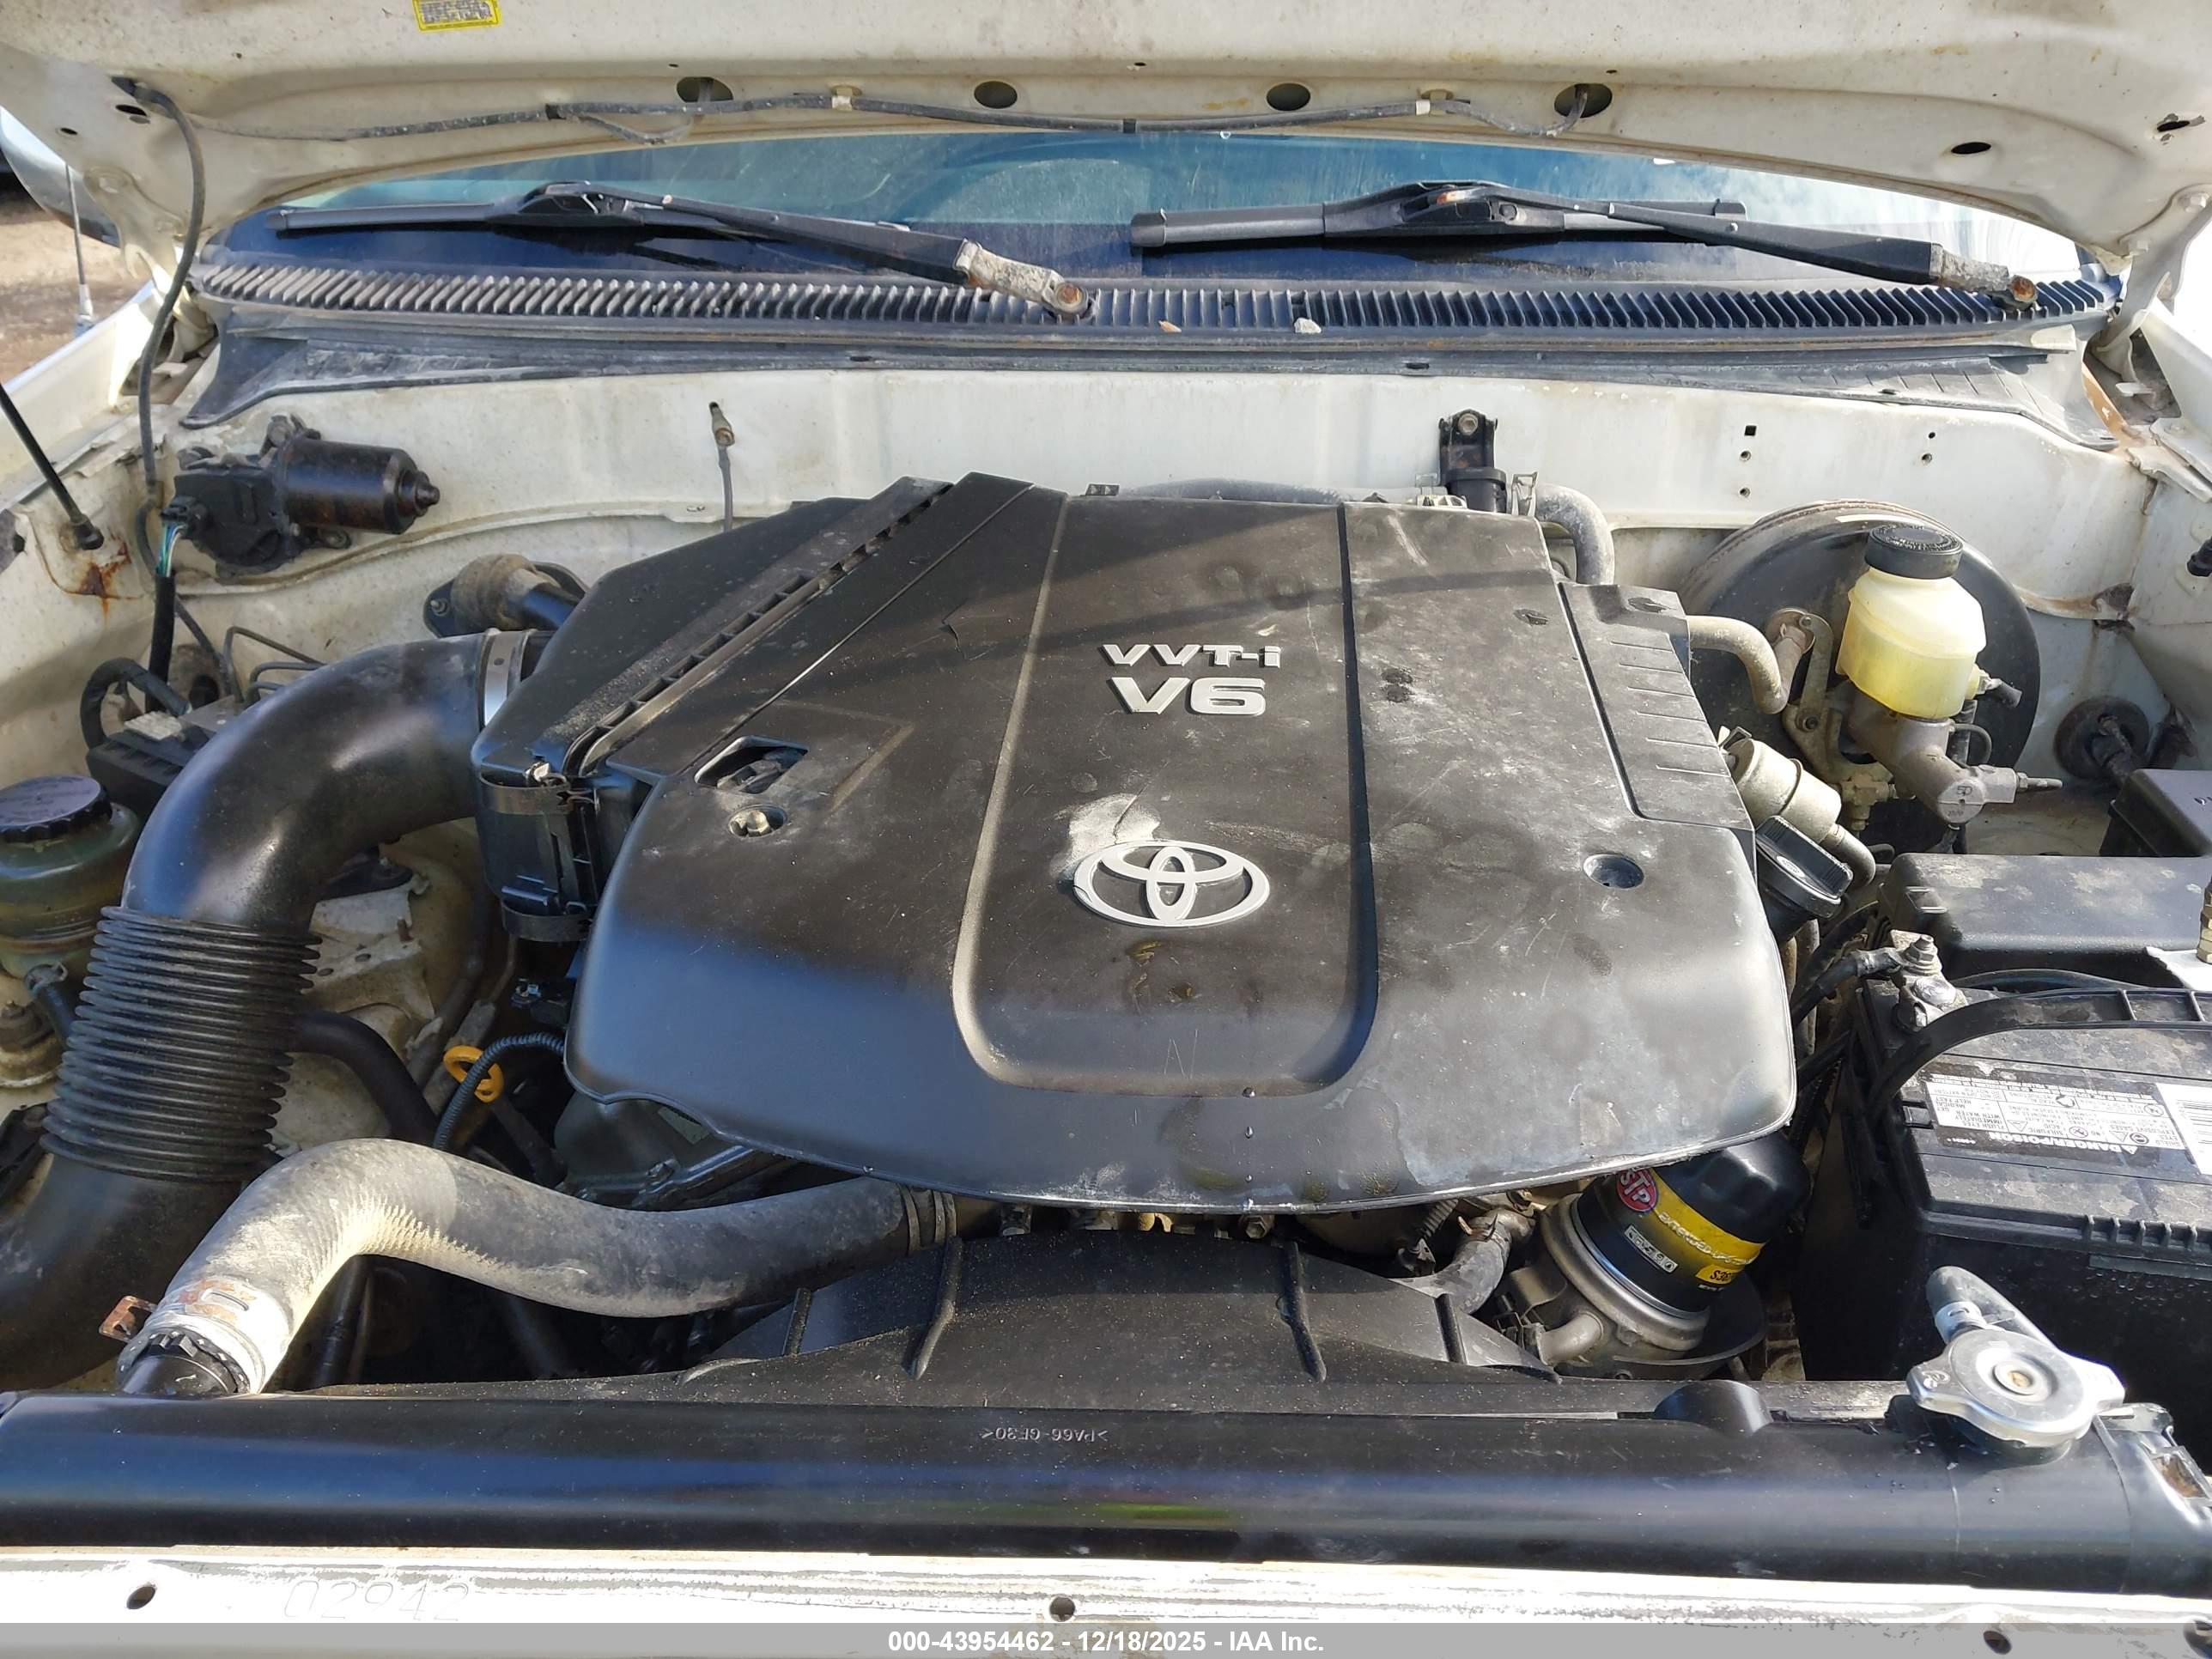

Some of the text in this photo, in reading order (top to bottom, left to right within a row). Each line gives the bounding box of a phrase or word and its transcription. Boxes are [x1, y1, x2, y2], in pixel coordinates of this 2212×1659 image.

[1099, 643, 1281, 668] VVT-i
[1107, 677, 1267, 716] V6
[1989, 1132, 2122, 1152] DANGER/POISON
[1619, 1170, 1651, 1203] STP
